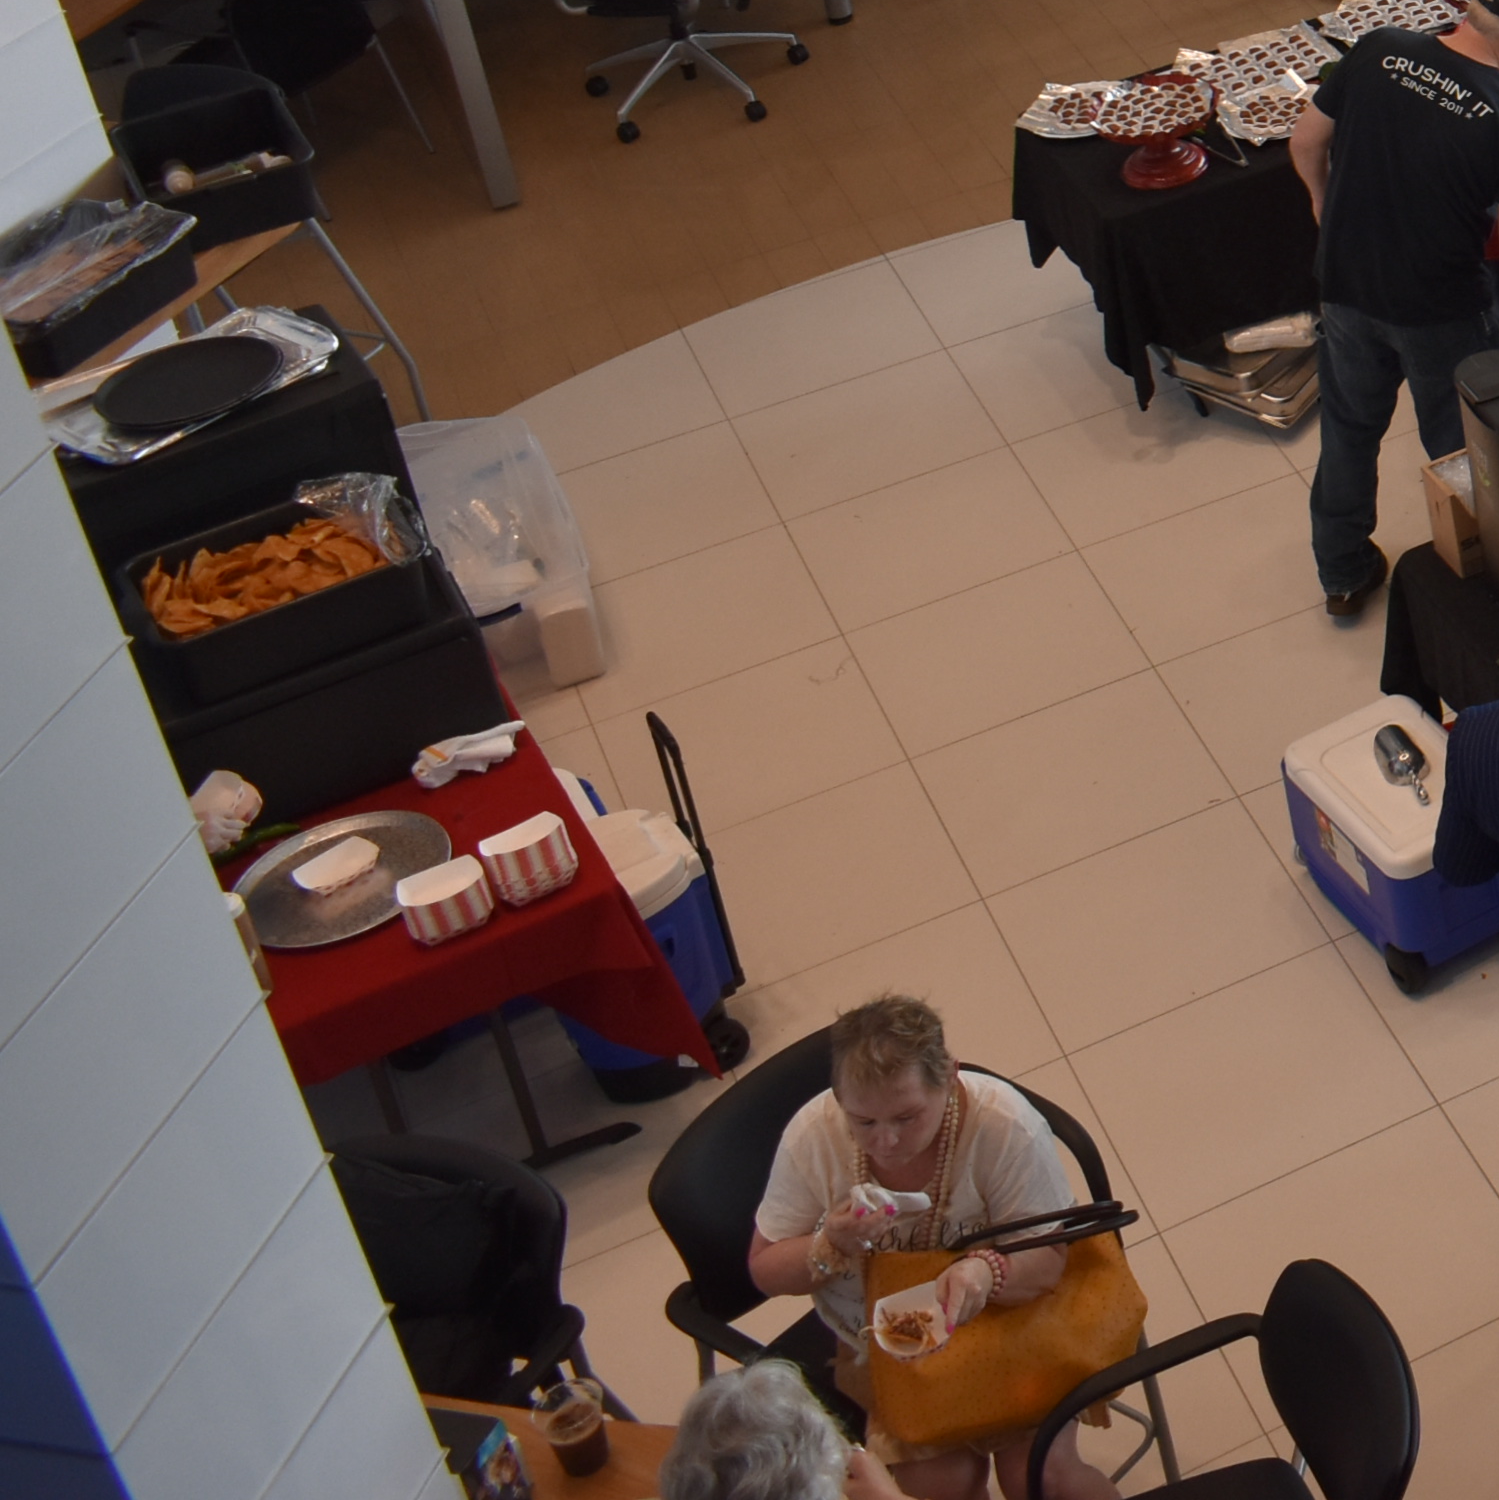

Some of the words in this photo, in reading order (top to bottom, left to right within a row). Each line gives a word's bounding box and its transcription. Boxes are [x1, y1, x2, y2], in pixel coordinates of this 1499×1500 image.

[1382, 56, 1472, 101] CRUSHIN'
[1472, 101, 1494, 118] IT
[1400, 76, 1437, 101] SINCE
[1439, 97, 1464, 116] 2011
